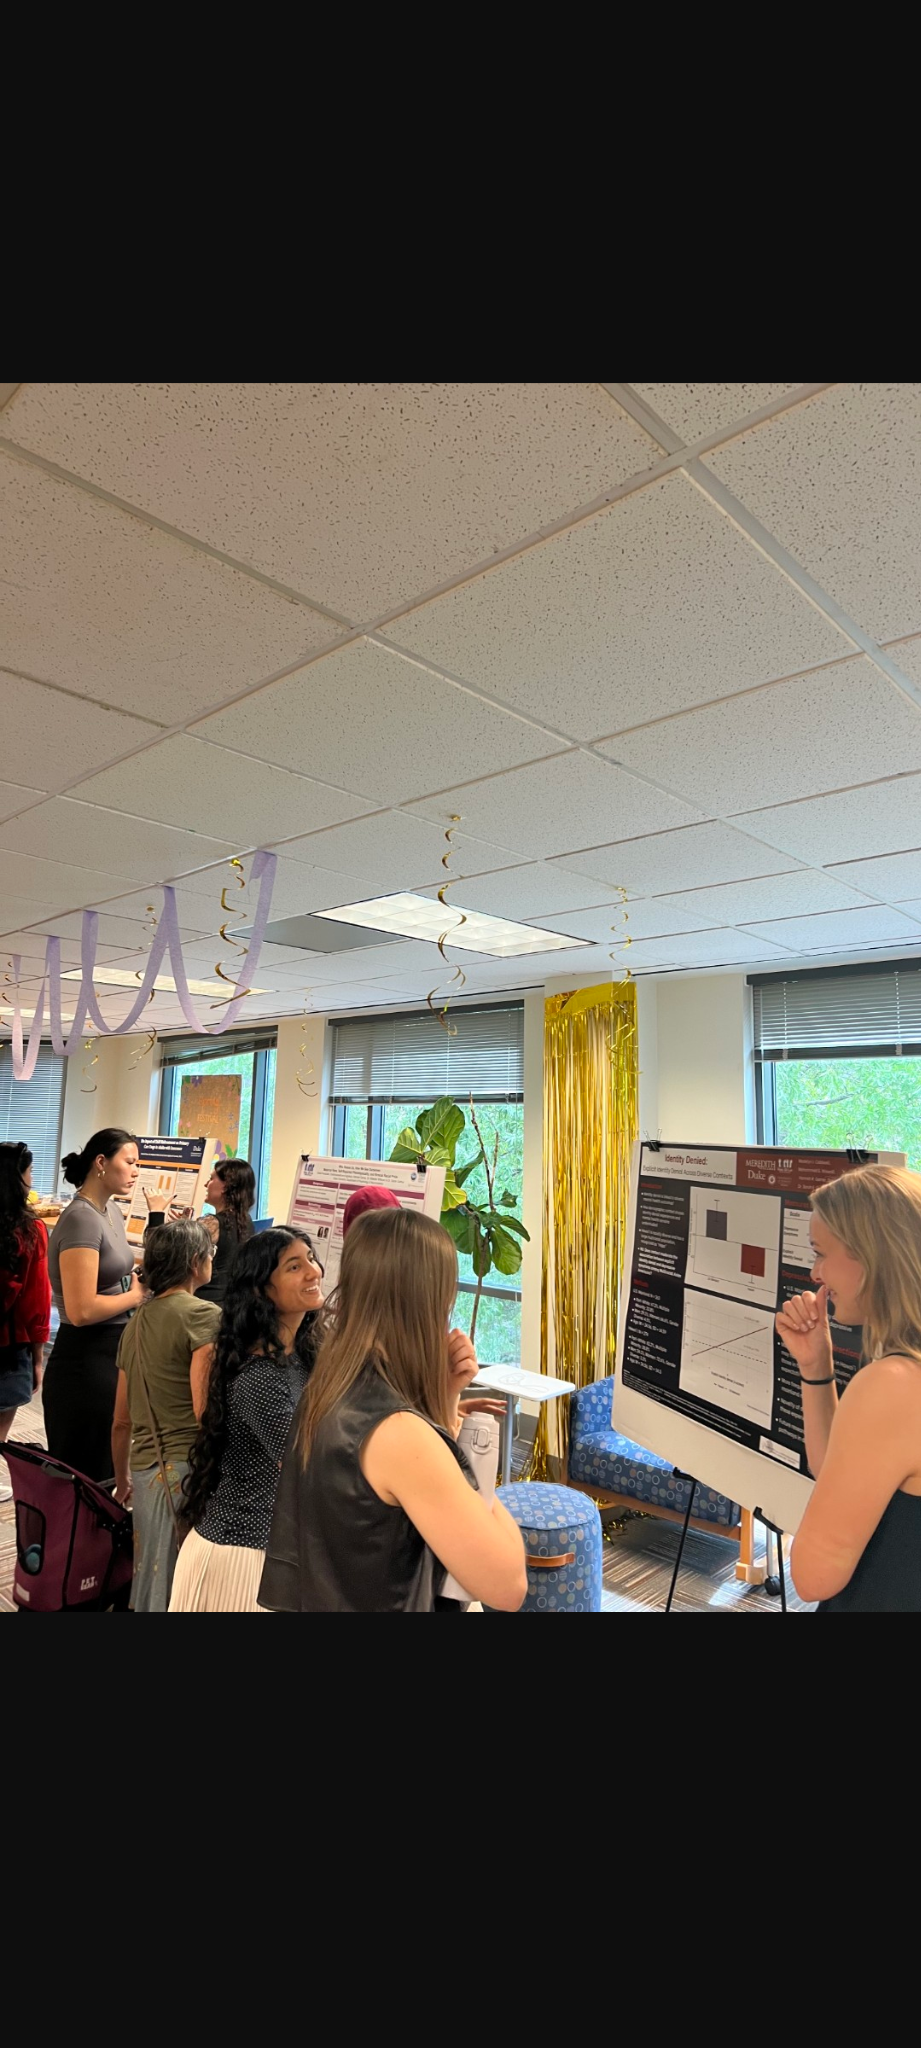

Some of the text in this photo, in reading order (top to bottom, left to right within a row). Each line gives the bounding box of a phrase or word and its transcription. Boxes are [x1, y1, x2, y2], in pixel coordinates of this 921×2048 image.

[665, 1154, 708, 1166] Identity Denied:
[745, 1159, 776, 1169] MEREDITH
[713, 1172, 733, 1180] Contexts
[747, 1170, 766, 1180] Duke
